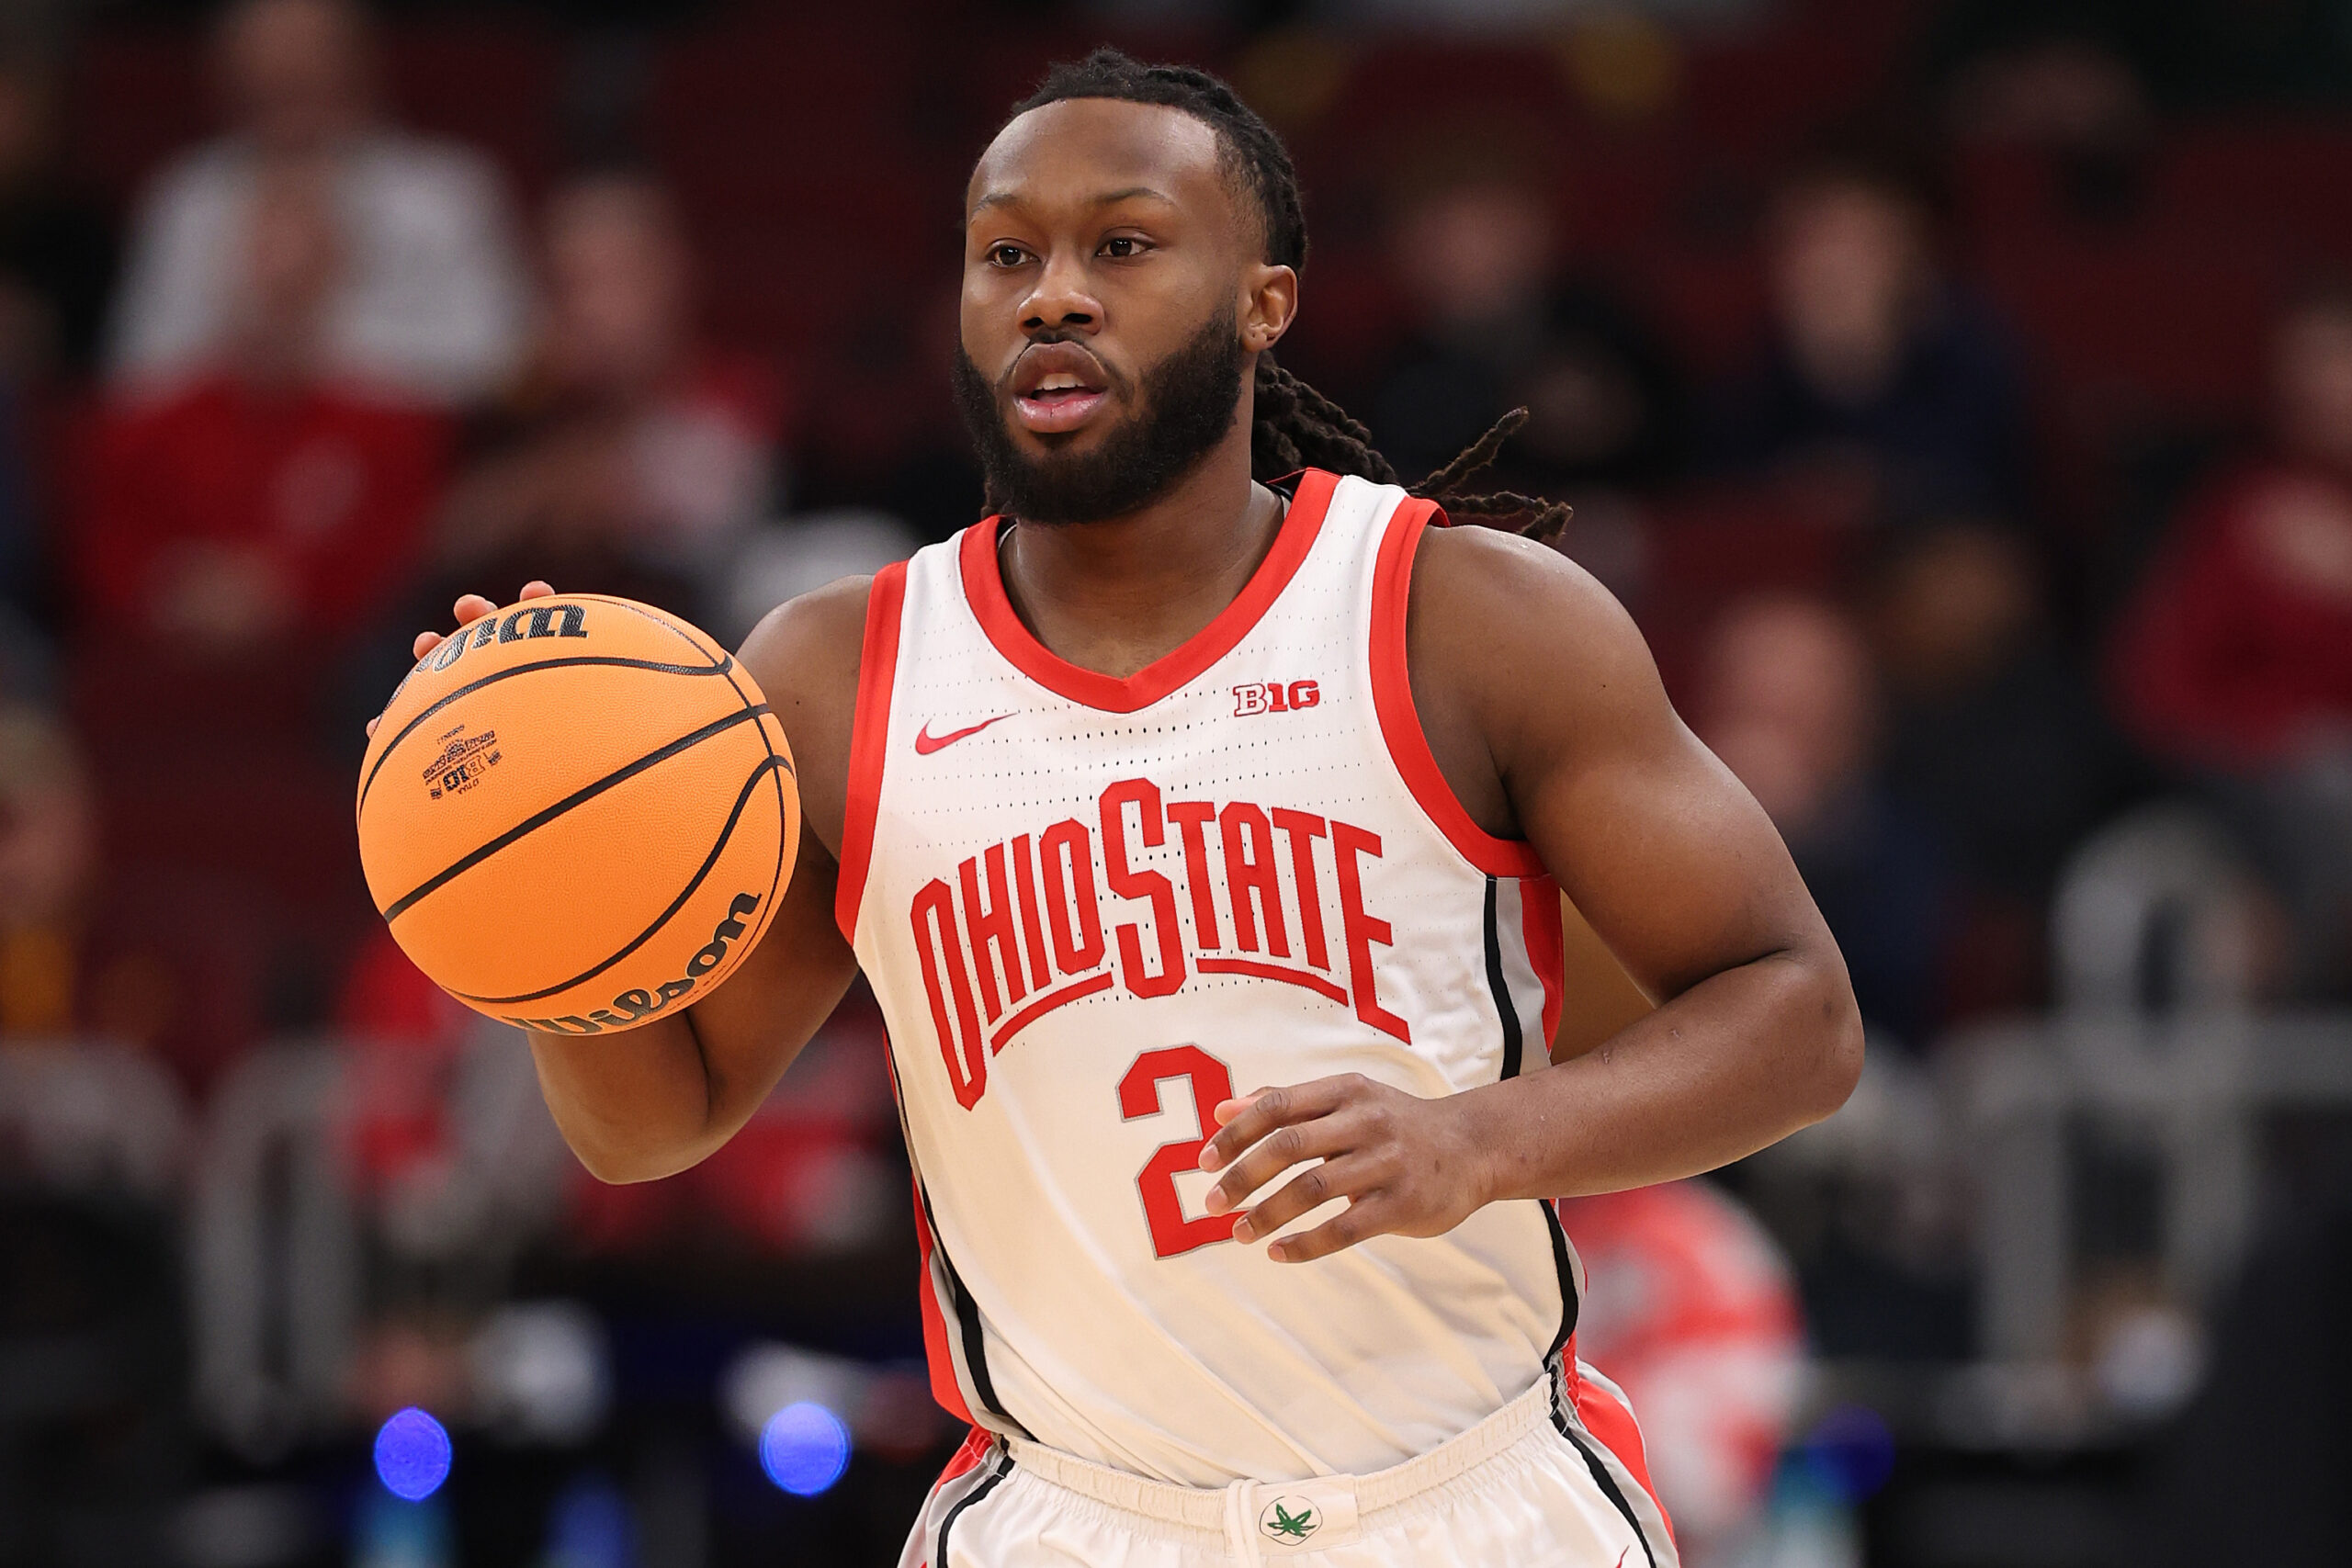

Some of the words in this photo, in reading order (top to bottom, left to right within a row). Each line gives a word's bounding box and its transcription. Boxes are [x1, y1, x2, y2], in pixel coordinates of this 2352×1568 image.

[501, 892, 763, 1034] Wilson
[910, 818, 1105, 1111] OHIO
[1099, 777, 1412, 1045] STATE
[1114, 1043, 1255, 1261] 2
